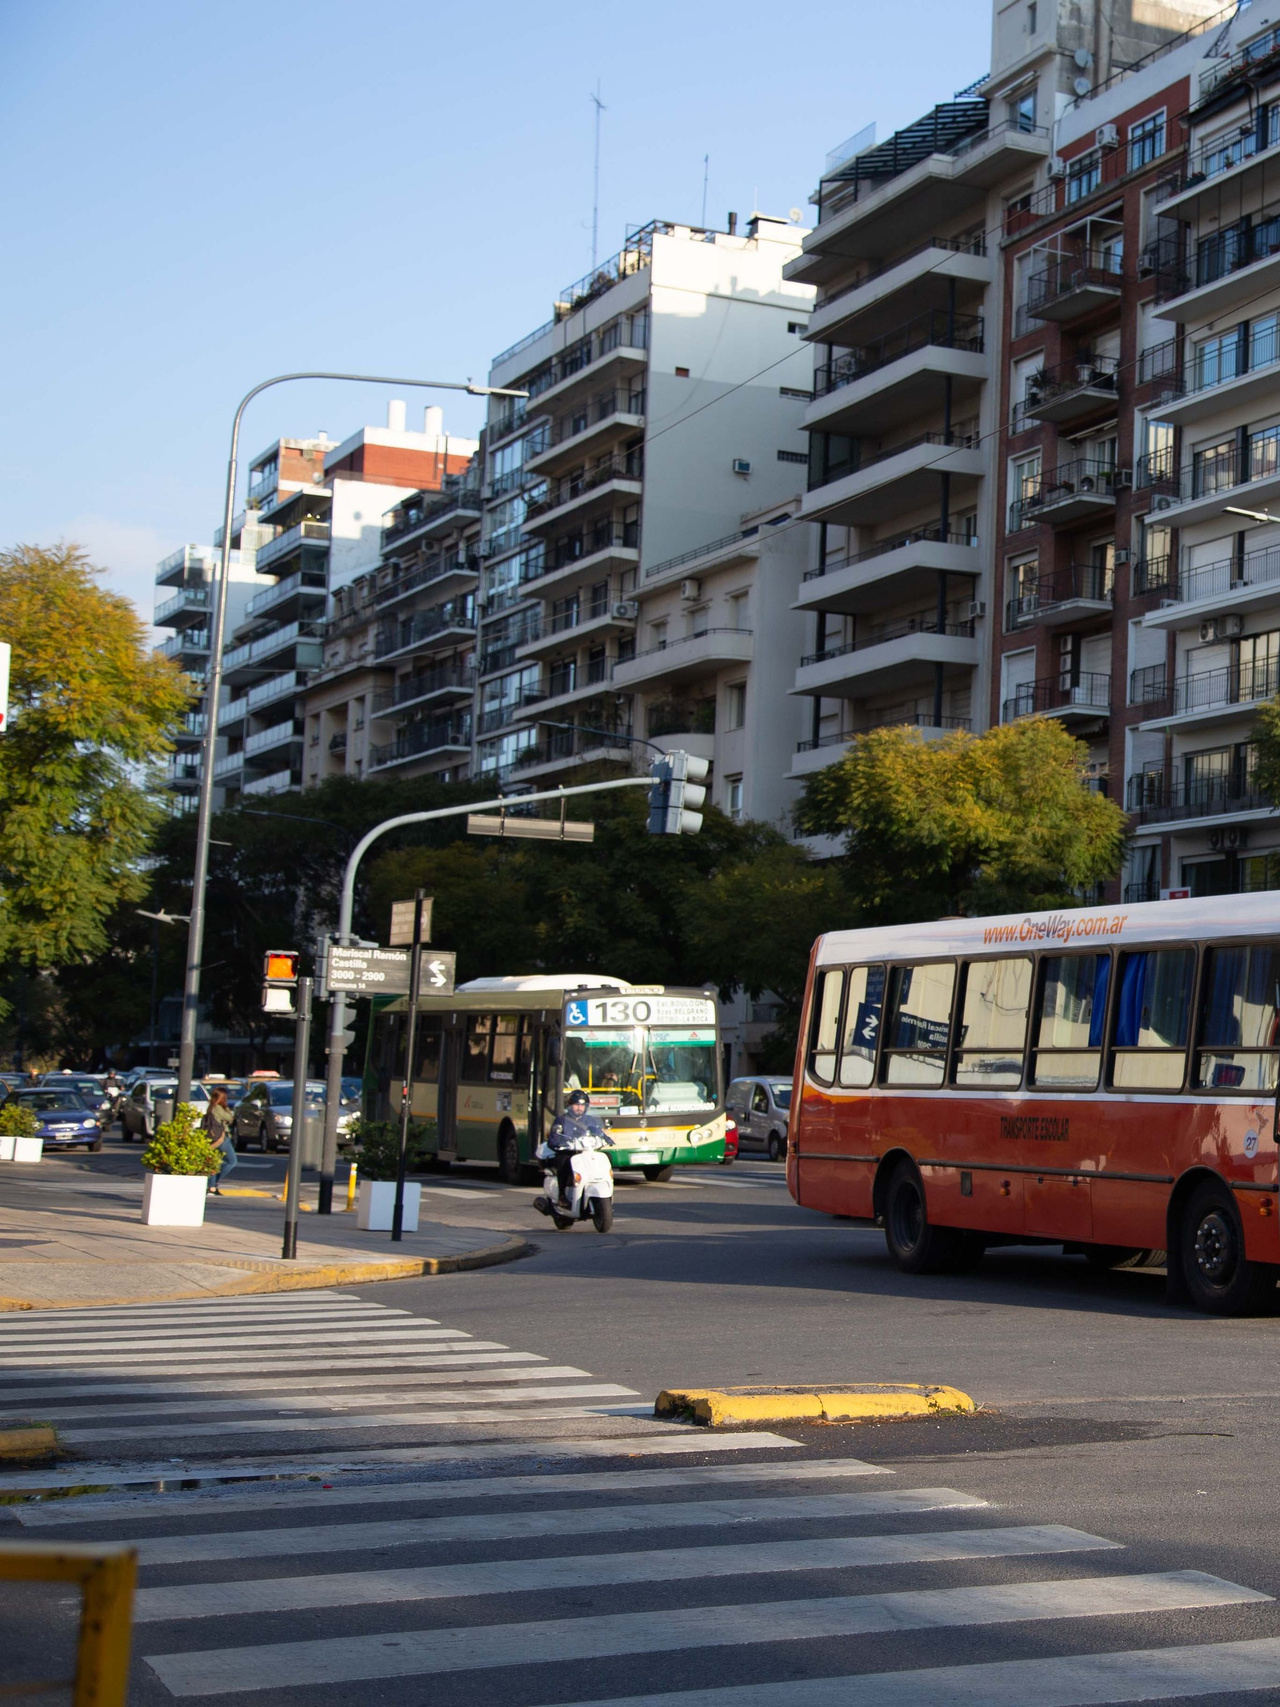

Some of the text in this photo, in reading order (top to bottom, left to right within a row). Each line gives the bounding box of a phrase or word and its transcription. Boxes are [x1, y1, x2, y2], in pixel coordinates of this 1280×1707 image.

[983, 914, 1128, 944] www.OneWay.com.ar
[332, 948, 407, 961] Mariscal Ramón
[331, 958, 368, 969] Castilla
[331, 970, 354, 980] 3000
[361, 971, 385, 982] 2900
[595, 1001, 651, 1023] 130
[1000, 1116, 1069, 1141] TRANSPORTE ESCOLAR
[1245, 1136, 1257, 1150] 27
